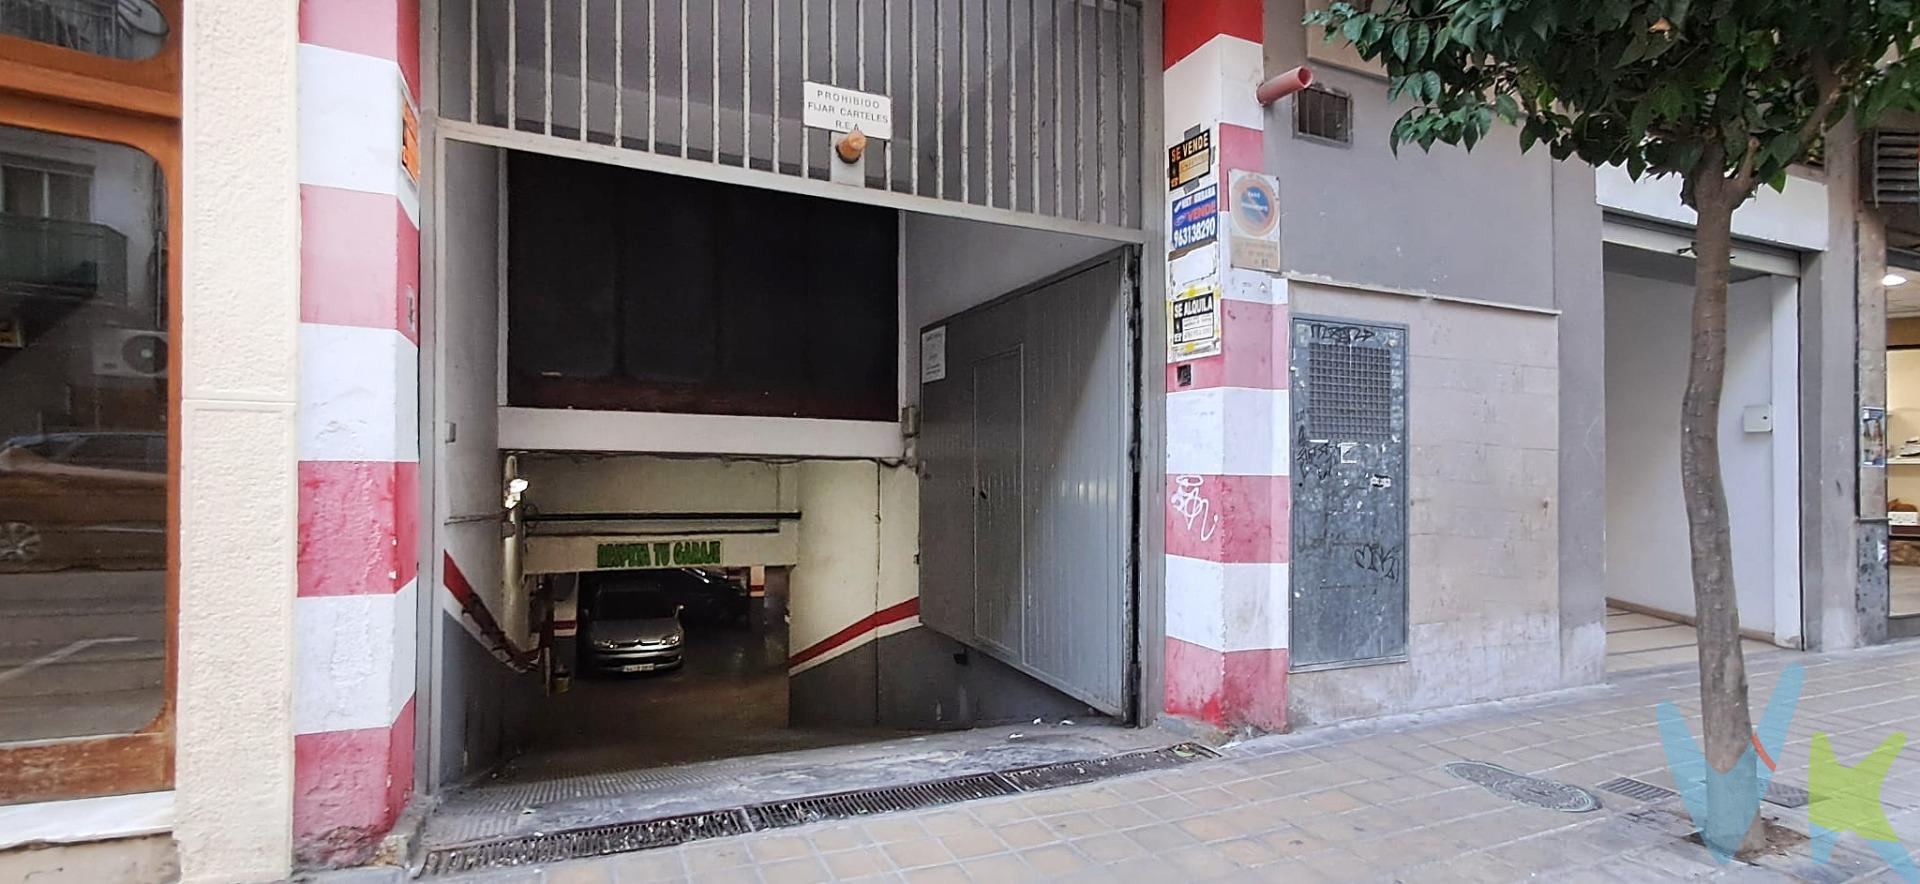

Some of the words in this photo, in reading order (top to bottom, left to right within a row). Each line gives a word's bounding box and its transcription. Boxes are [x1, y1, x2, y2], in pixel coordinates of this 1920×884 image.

[817, 90, 880, 109] PROHIBIDO
[808, 101, 835, 114] FIJAR
[840, 108, 888, 123] CARTELES
[1171, 146, 1181, 163] SE
[1182, 132, 1209, 157] VENDE
[1174, 216, 1216, 248] 963138290
[1174, 302, 1183, 318] SE
[1184, 296, 1213, 316] ALQUILA
[653, 543, 671, 566] TU
[674, 541, 721, 565] GARAJE
